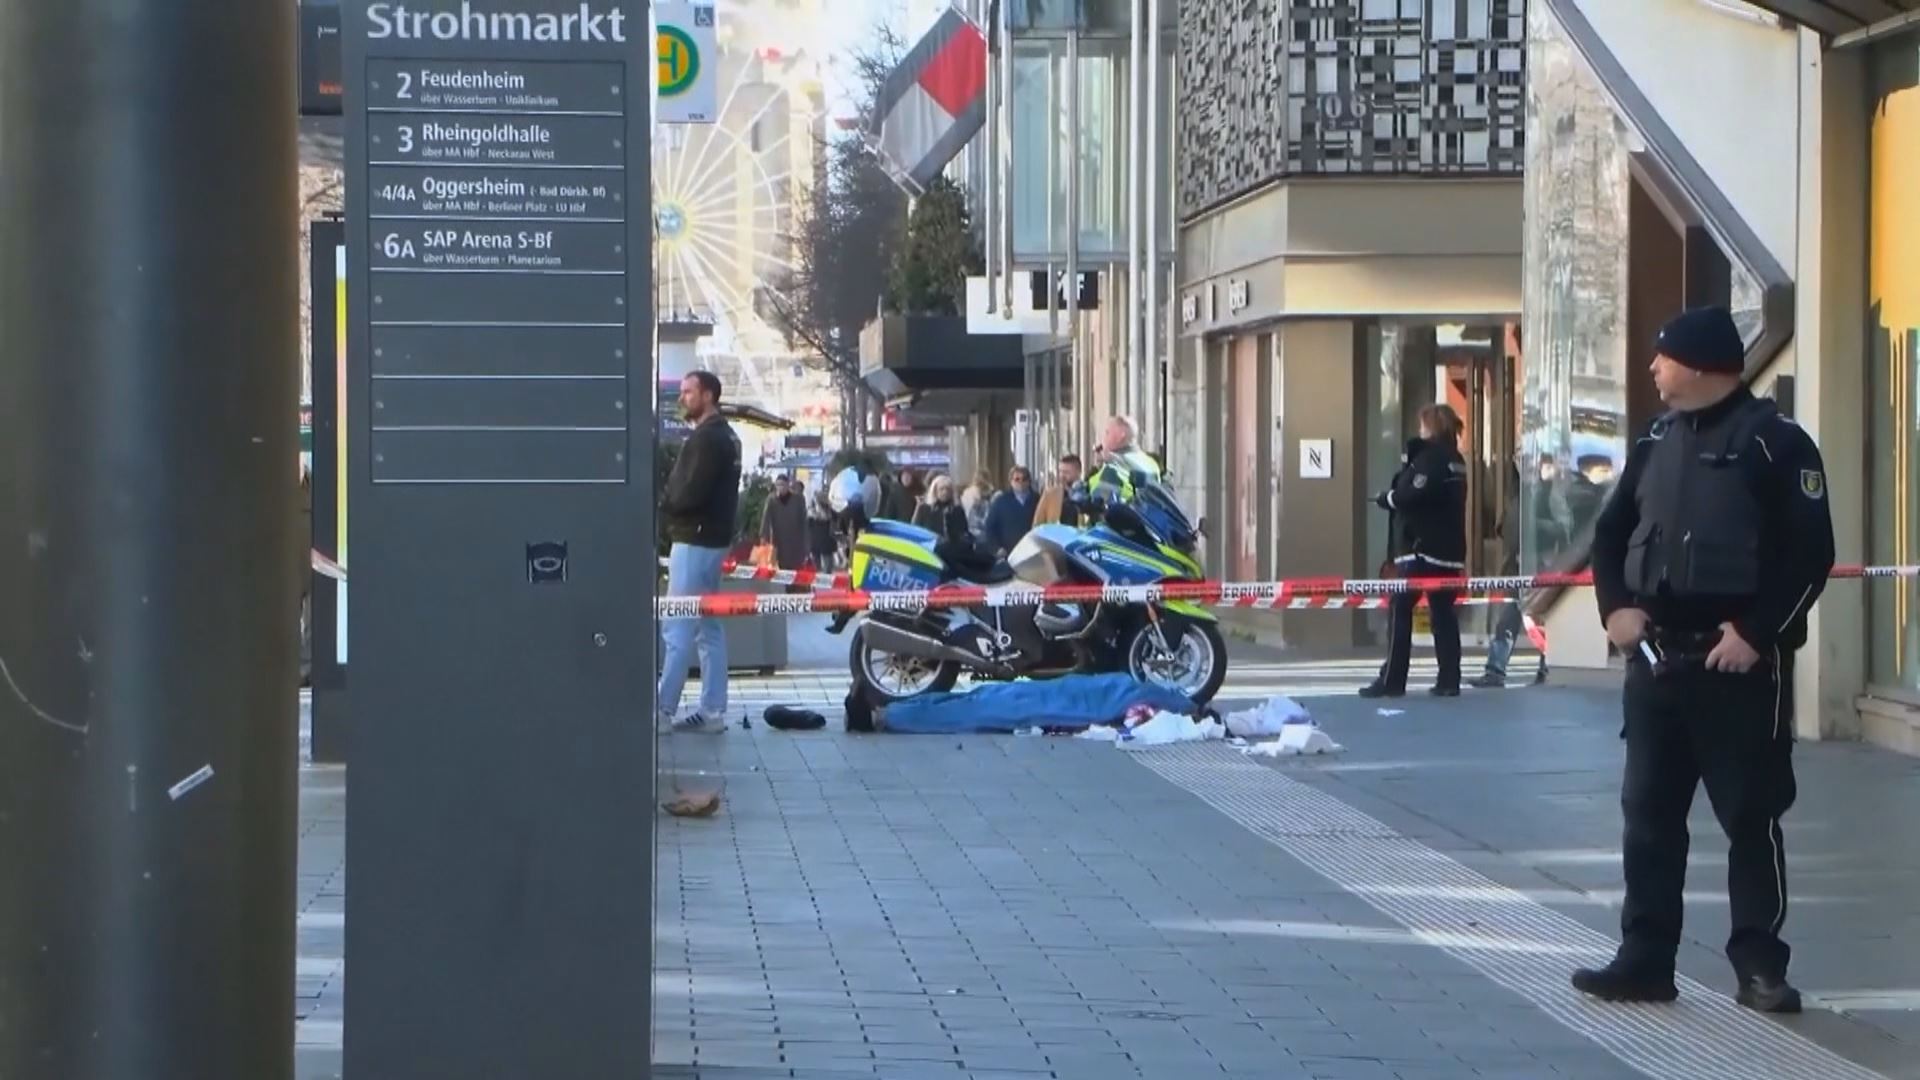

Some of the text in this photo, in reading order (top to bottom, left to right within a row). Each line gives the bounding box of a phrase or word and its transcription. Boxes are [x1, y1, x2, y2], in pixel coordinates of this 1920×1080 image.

[367, 2, 625, 42] Strohmarkt
[396, 72, 412, 98] 2
[421, 69, 525, 88] Feudenheim
[443, 93, 496, 105] Wasserturm
[505, 95, 559, 106] Uniklinikum
[398, 126, 413, 152] 3
[422, 123, 550, 146] Rheingoldhalle
[444, 147, 461, 157] MA
[464, 148, 480, 158] Hbf
[531, 150, 554, 160] West
[382, 184, 416, 201] 4/4A
[422, 177, 525, 199] Oggersheim
[540, 186, 558, 197] Bad
[445, 201, 461, 211] MA
[464, 201, 480, 212] Hbf
[488, 202, 522, 213] Berliner
[525, 202, 547, 213] Platz
[383, 232, 416, 258] 6A
[423, 229, 553, 249] SAP Arena S-Bf
[446, 254, 499, 265] Wasserturm
[508, 255, 561, 266] Planetarium
